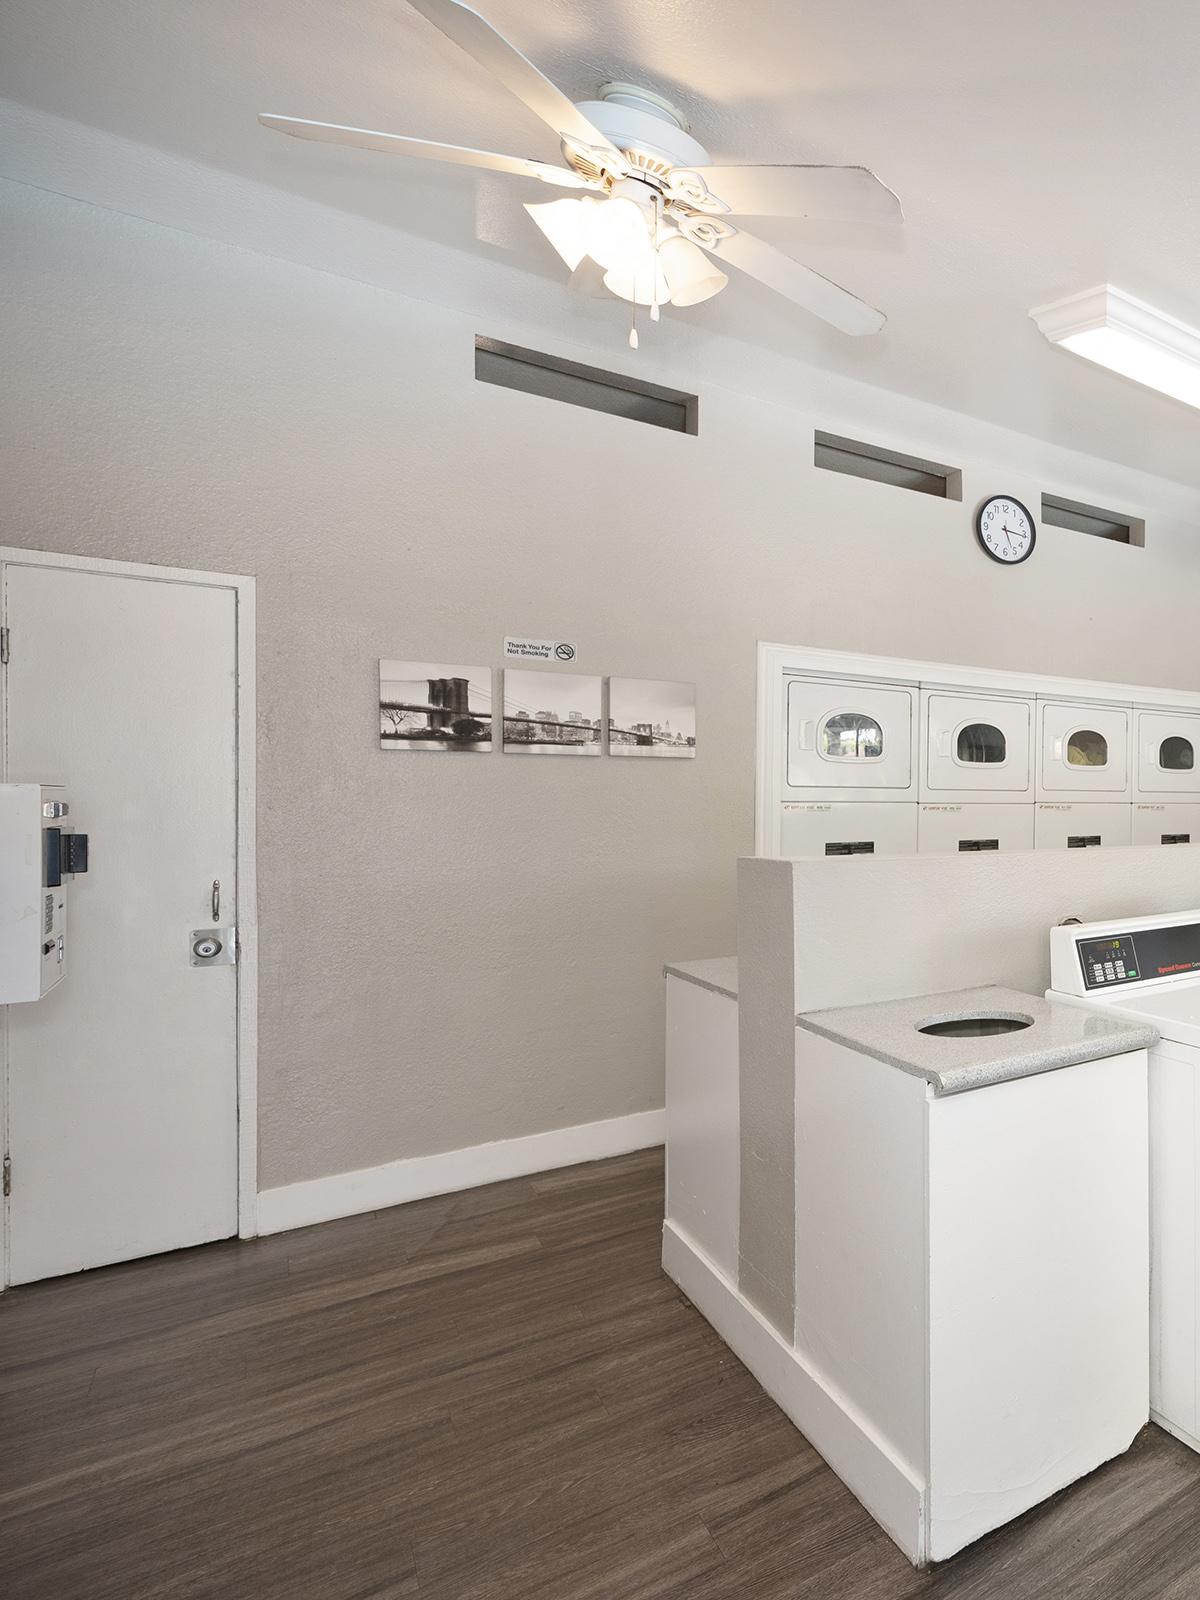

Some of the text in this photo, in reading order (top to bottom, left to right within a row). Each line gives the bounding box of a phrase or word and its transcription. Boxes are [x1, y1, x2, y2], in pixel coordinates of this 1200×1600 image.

[994, 505, 999, 514] 11
[1002, 505, 1009, 513] 12
[1013, 509, 1016, 518] 1
[987, 511, 994, 521] 10
[984, 522, 988, 531] 9
[1019, 519, 1024, 527] 2
[986, 534, 992, 543] 8
[994, 543, 999, 551] 7
[1013, 547, 1017, 555] 5
[1003, 548, 1008, 556] 6
[521, 649, 549, 658] Smoking
